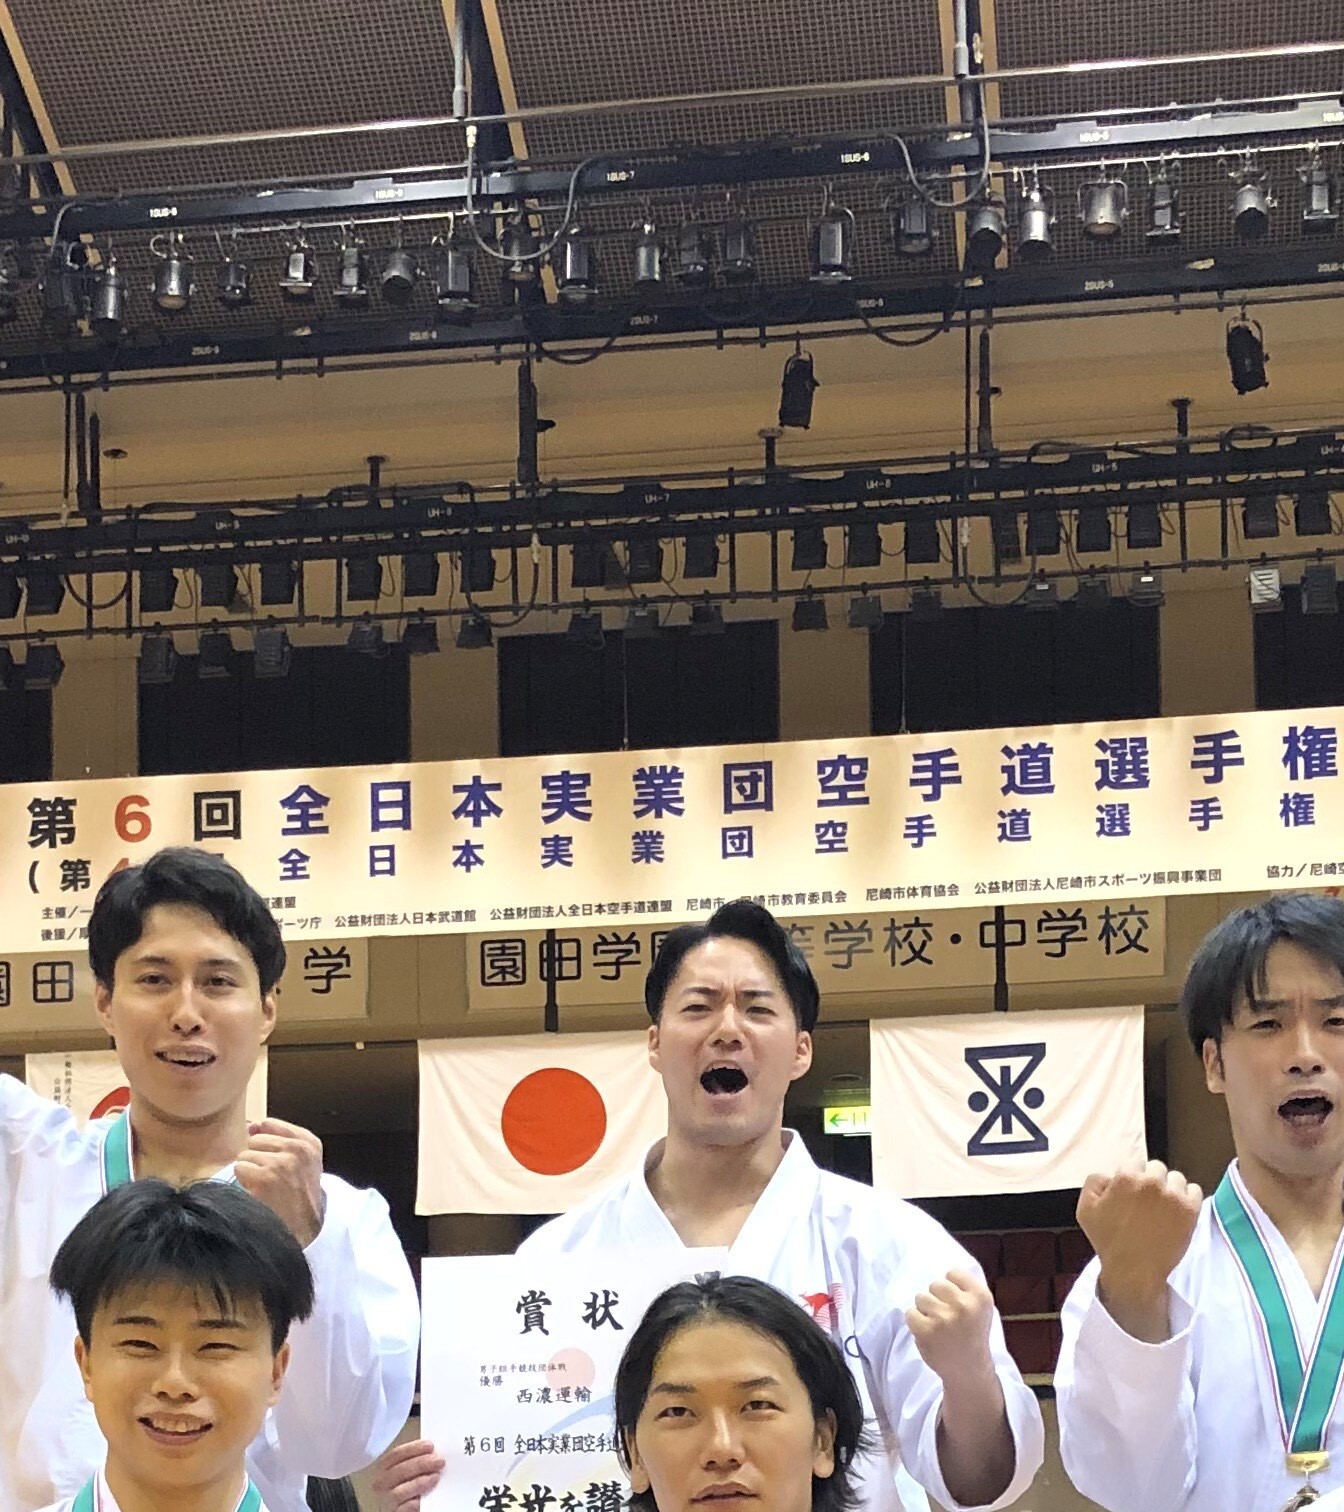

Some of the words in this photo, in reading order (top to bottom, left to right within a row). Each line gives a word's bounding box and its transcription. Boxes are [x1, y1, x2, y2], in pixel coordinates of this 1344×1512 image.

[516, 1289, 624, 1336] 賞状
[516, 1386, 593, 1405] 西濃運輸
